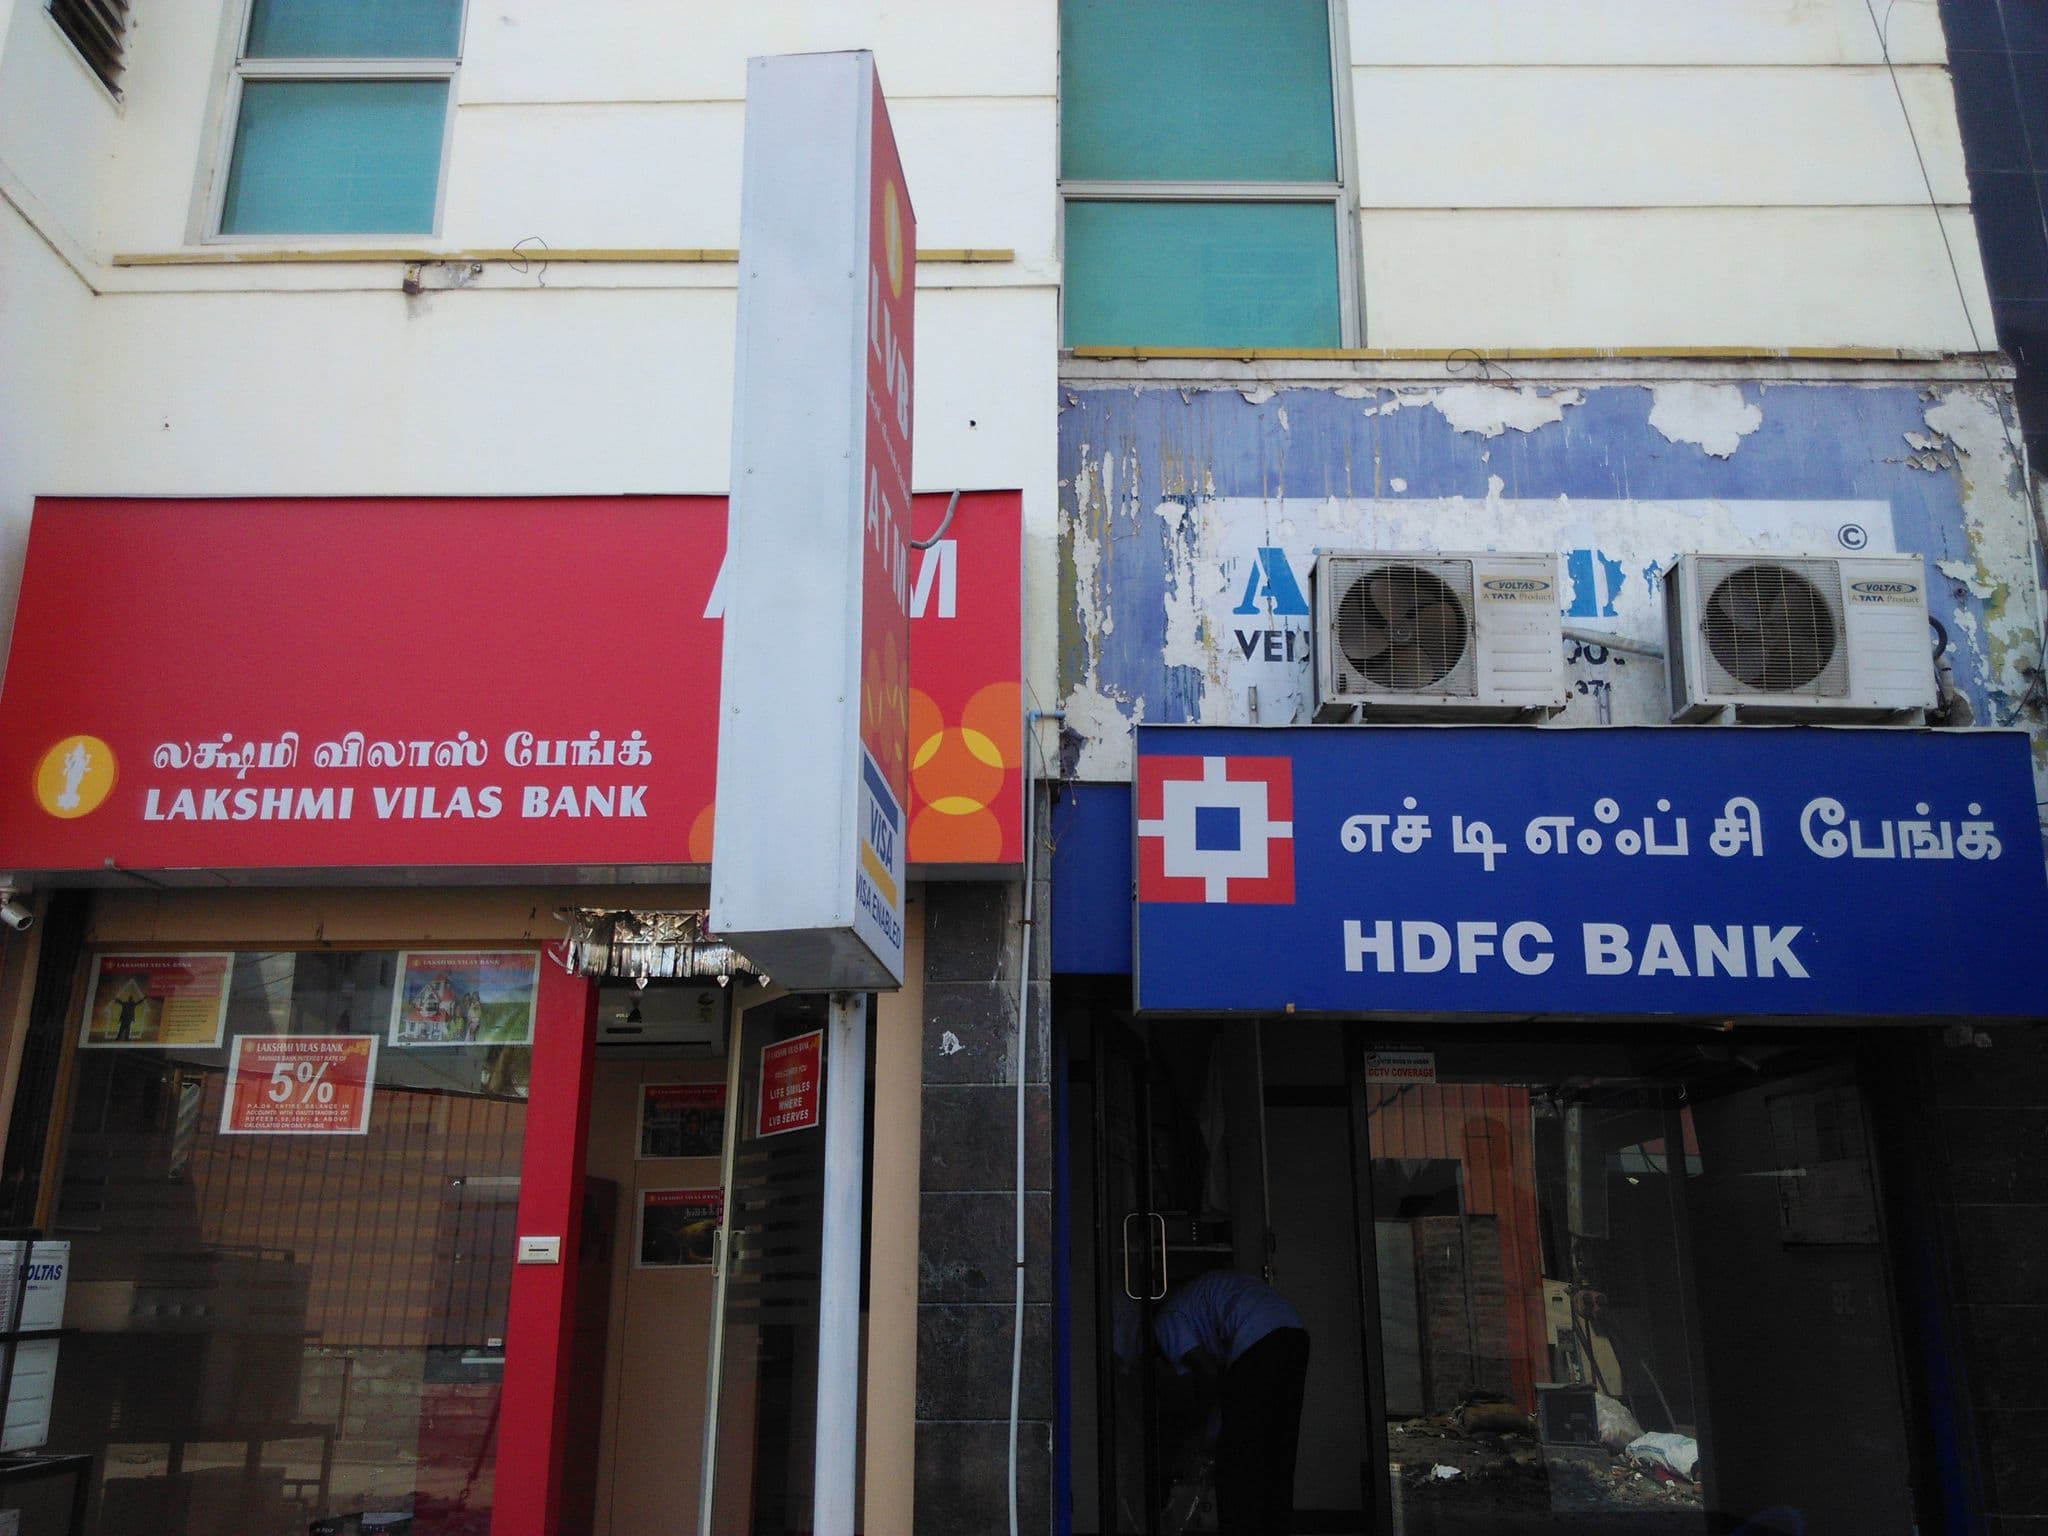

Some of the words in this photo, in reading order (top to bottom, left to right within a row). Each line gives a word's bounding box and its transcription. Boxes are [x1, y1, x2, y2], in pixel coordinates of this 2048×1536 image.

[870, 263, 909, 441] LVB
[868, 463, 908, 617] ATM
[1491, 592, 1517, 600] TATA
[1498, 582, 1535, 590] VOLTAS
[1859, 594, 1885, 602] TATA
[1866, 584, 1903, 592] VOLTAS
[1234, 629, 1310, 662] VEN
[314, 731, 489, 768] விலாஸ்
[504, 730, 653, 767] பேங்க்
[144, 786, 355, 821] LAKSHMI
[373, 785, 503, 820] VILAS
[521, 784, 649, 819] BANK
[869, 797, 894, 874] VISA
[1340, 796, 1433, 854] எச்
[1452, 815, 1507, 872] டி
[1709, 796, 1764, 857] சி
[1800, 796, 2003, 861] பேங்க்
[855, 868, 871, 916] VISA
[871, 894, 900, 950] ENABLED
[1343, 920, 1555, 976] HDFC
[1582, 922, 1811, 978] BANK
[257, 1043, 294, 1053] LAKSHMI
[295, 1042, 318, 1052] VILAS
[320, 1042, 343, 1052] BANK
[268, 1061, 334, 1104] 5%
[1391, 1067, 1434, 1078] COVERAGE
[770, 1088, 785, 1100] LIFE
[786, 1081, 811, 1096] SMILES
[779, 1097, 803, 1111] WHERE
[768, 1115, 782, 1127] LVB
[782, 1109, 809, 1124] SERVES
[19, 1264, 63, 1281] OLTAS
